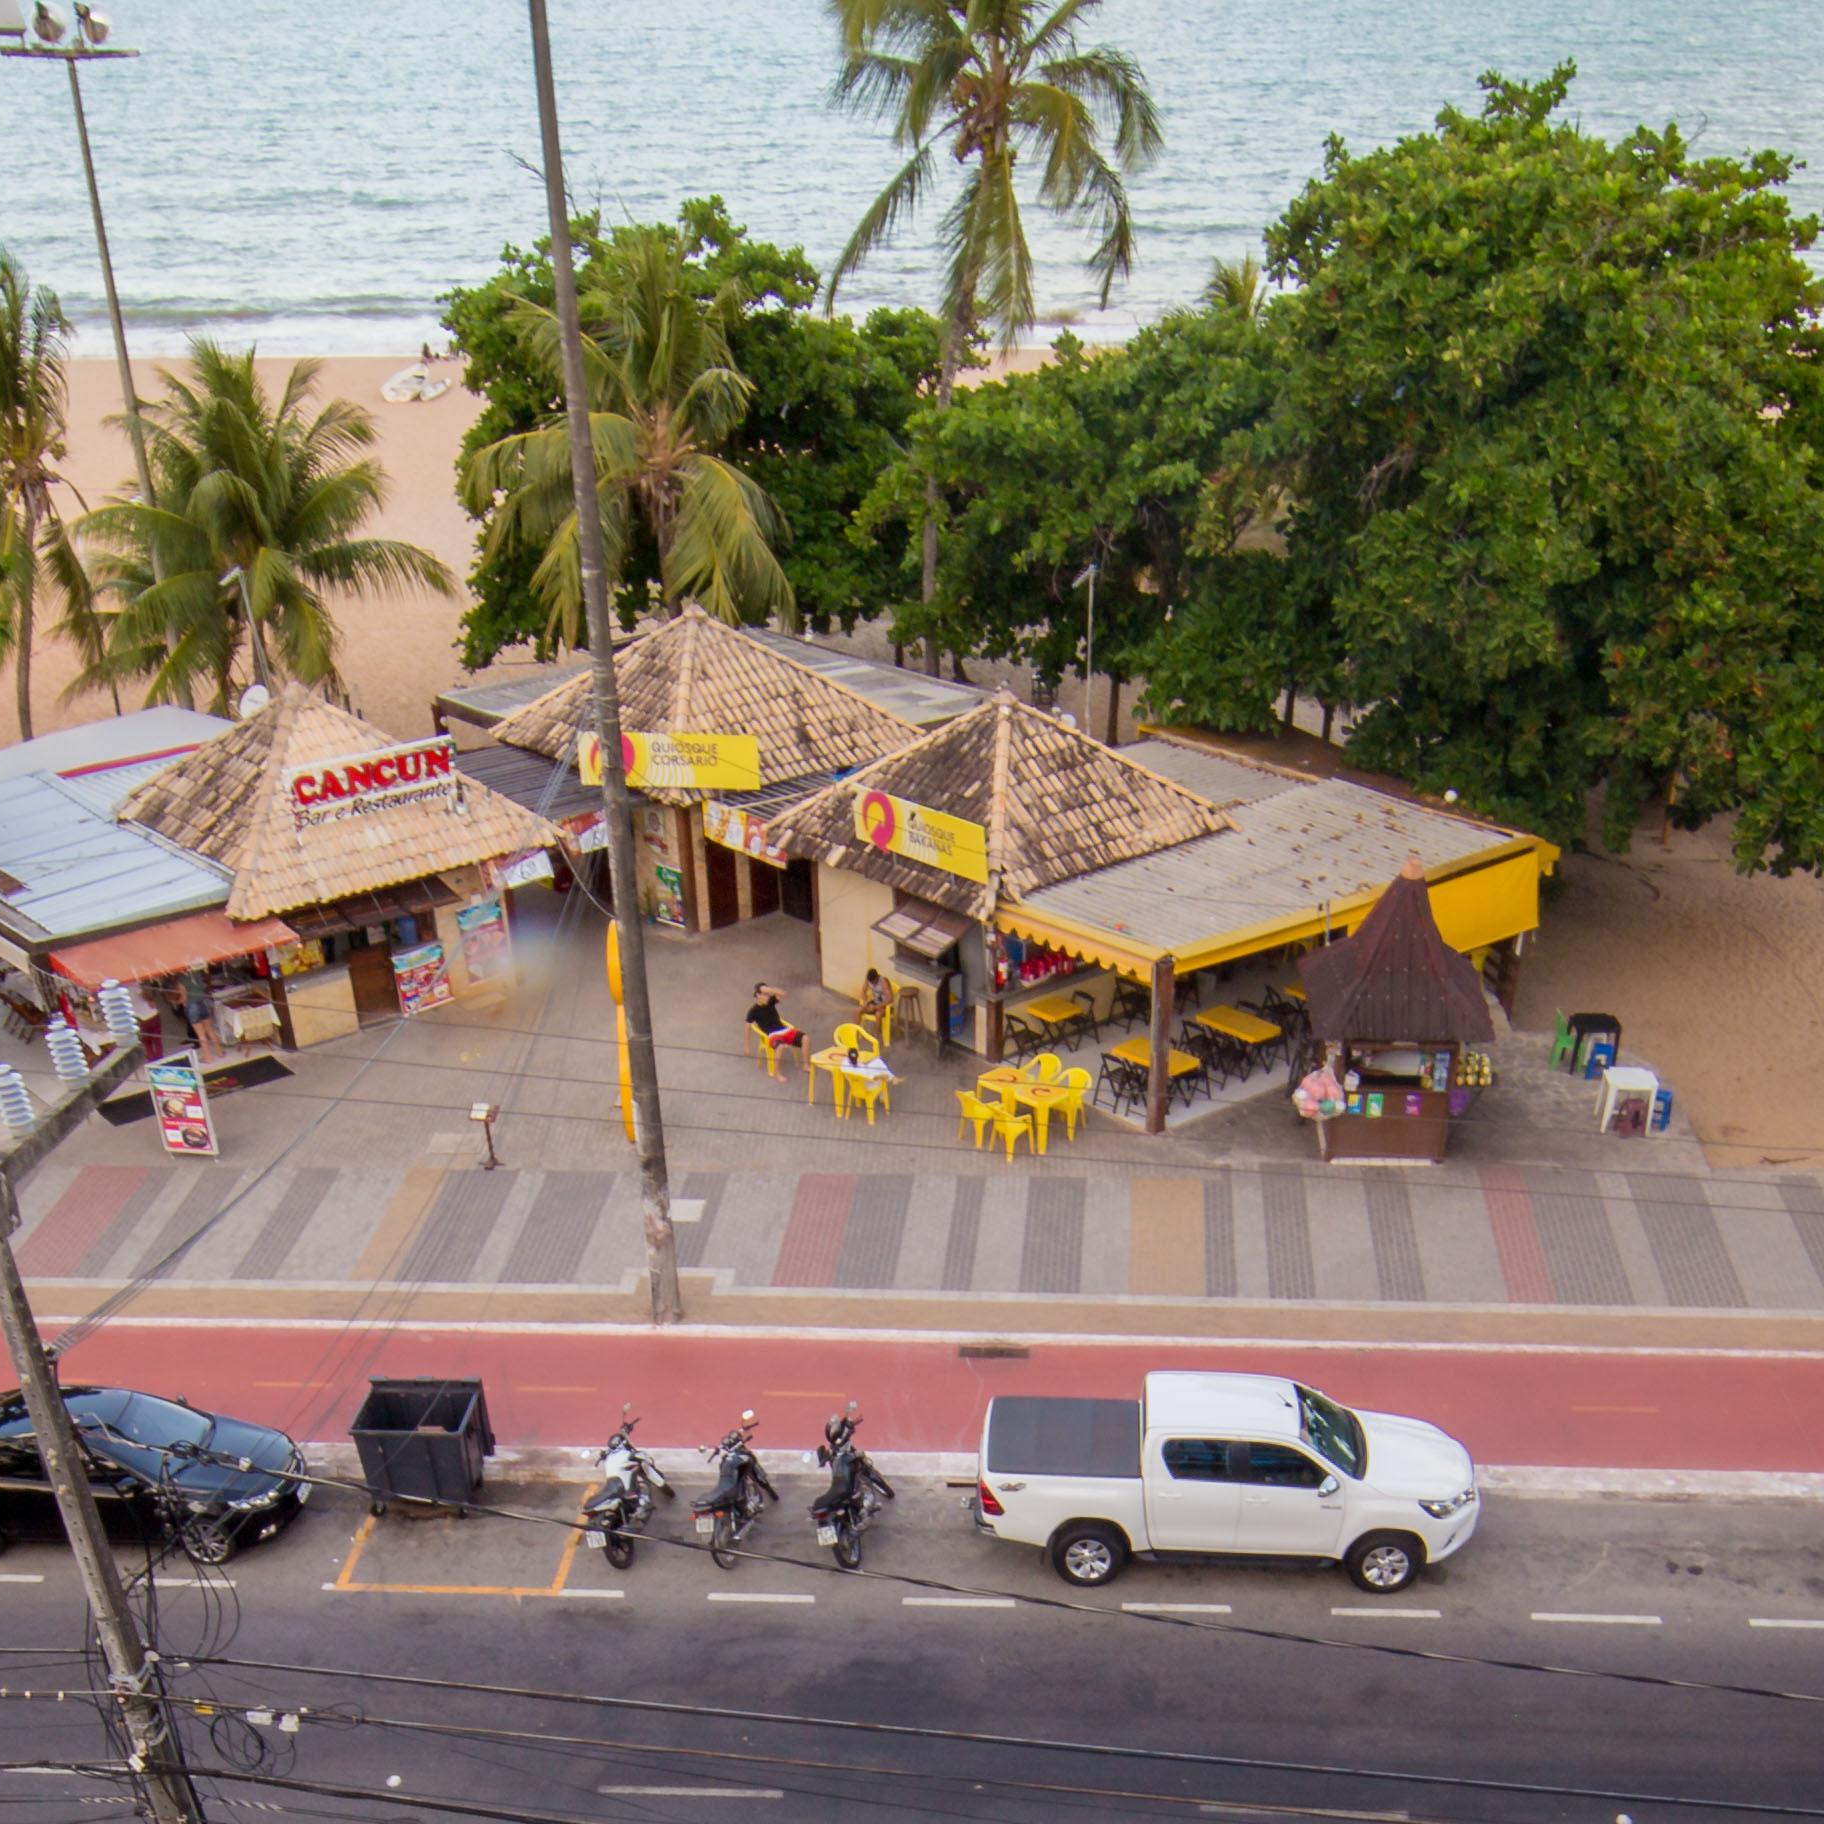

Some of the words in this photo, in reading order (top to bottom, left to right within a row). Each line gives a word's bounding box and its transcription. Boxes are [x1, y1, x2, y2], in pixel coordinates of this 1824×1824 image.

[651, 741, 718, 754] QUIOSQUE
[293, 745, 451, 805] CANCUN
[297, 809, 330, 828] Bar
[335, 806, 346, 820] e
[350, 781, 452, 816] Restaurante
